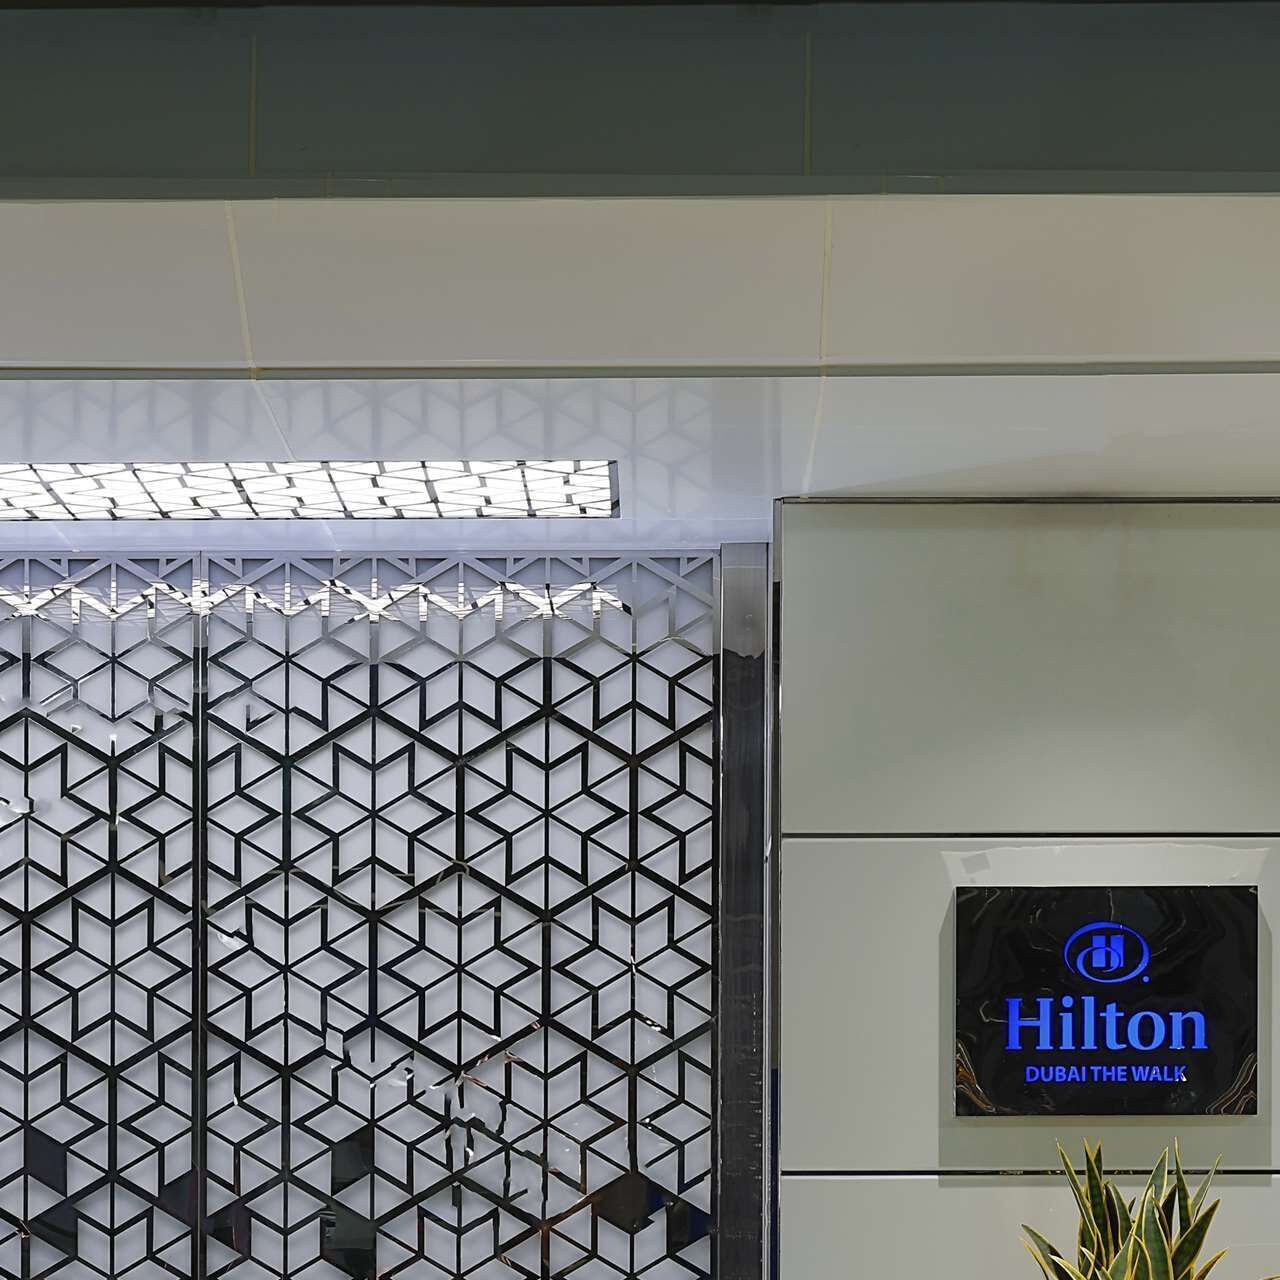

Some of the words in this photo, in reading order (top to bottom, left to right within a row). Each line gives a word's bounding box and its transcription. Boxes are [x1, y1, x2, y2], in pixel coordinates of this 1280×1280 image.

[1005, 996, 1208, 1050] Hilton
[1024, 1065, 1086, 1082] DUBAI
[1090, 1065, 1127, 1082] THE
[1131, 1065, 1188, 1082] WALK
